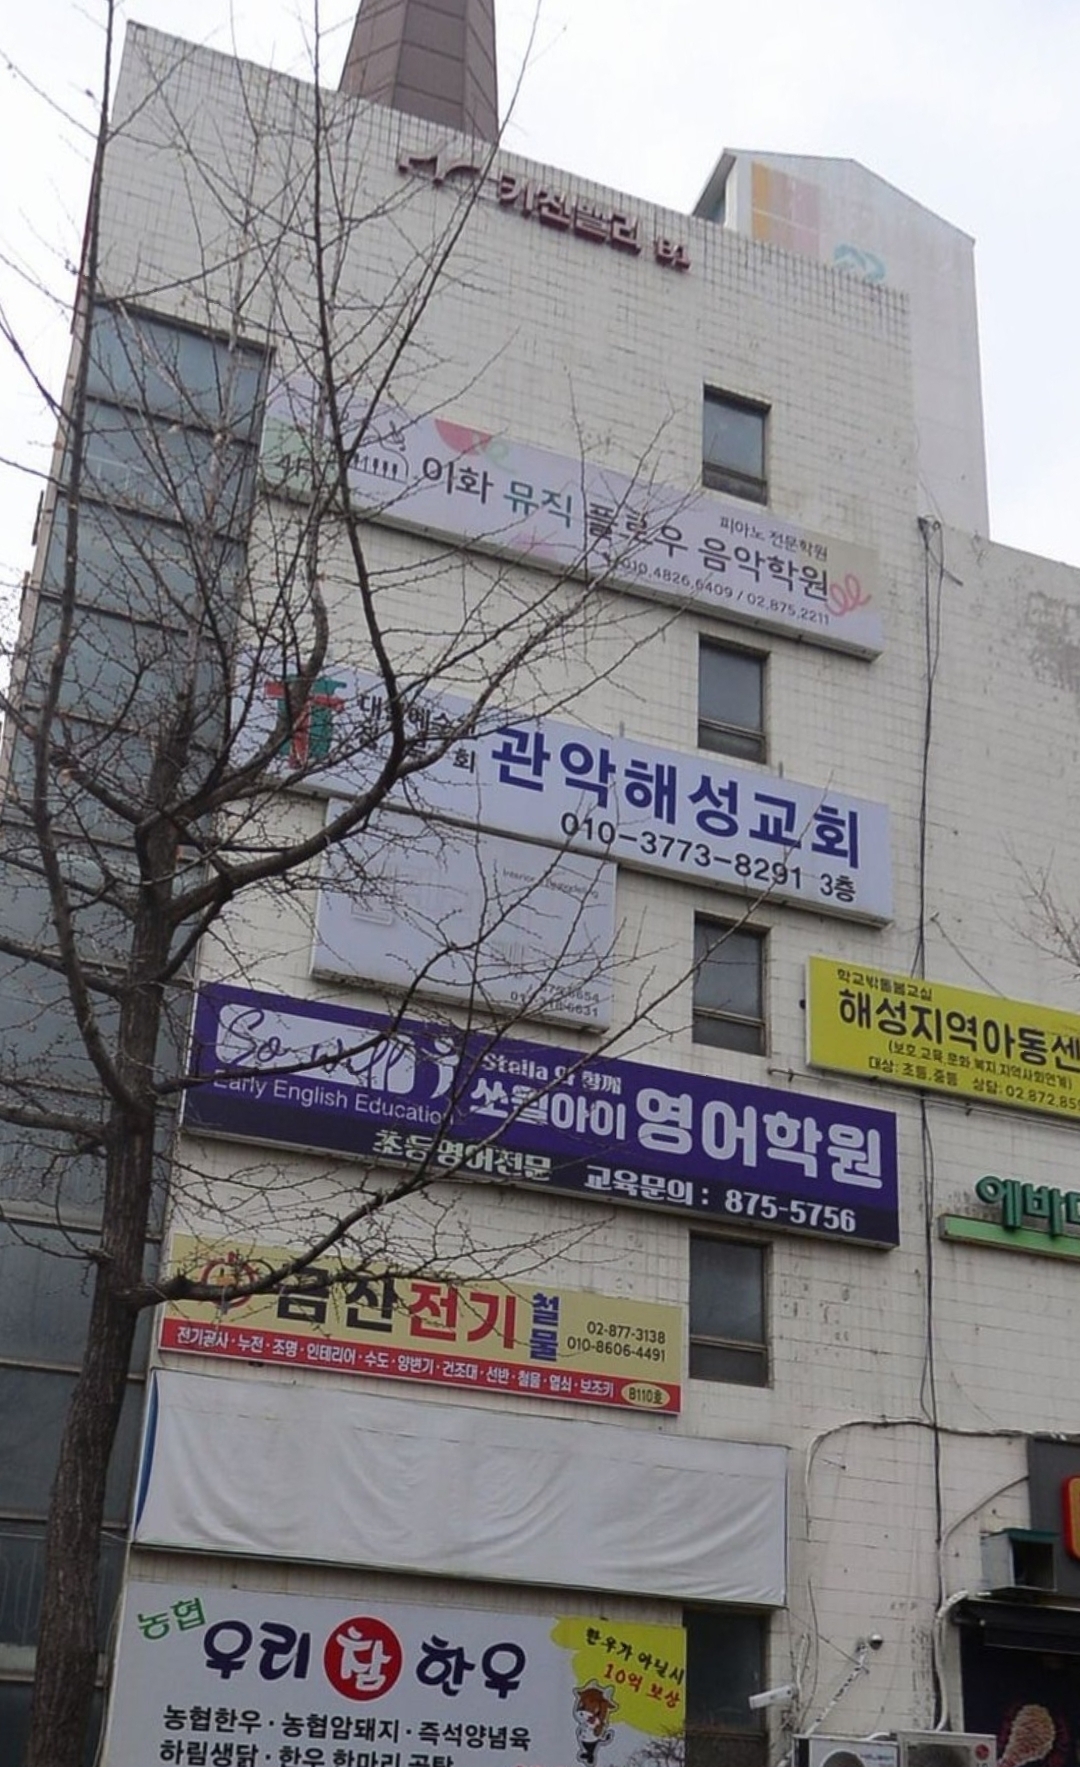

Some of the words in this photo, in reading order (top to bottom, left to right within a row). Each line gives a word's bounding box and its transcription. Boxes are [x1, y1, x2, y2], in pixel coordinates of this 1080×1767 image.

[423, 457, 493, 504] 이화
[503, 480, 572, 529] 뮤직
[698, 536, 828, 602] 음악학원
[720, 516, 765, 541] 피아노
[769, 530, 828, 562] 전문학원
[491, 728, 860, 869] 관악해성교회
[561, 812, 802, 890] 010-3773-8291
[819, 873, 857, 902] 3층
[838, 988, 1080, 1073] 해성지역아동센
[213, 1069, 267, 1098] Early
[274, 1080, 348, 1109] English
[482, 1052, 549, 1081] Stella
[581, 1071, 621, 1095] 함께
[637, 1088, 883, 1189] 영어학원
[372, 1129, 552, 1181] 초등영어전문
[724, 1189, 857, 1233] 875-5756
[530, 1292, 560, 1362] 철물
[567, 1336, 665, 1362] 010-8606-4491
[587, 1321, 665, 1345] 02-877-3138
[177, 1326, 229, 1349] 전기공사
[238, 1334, 264, 1353] 누전
[272, 1338, 299, 1357] 조명
[307, 1343, 356, 1365] 인테리어
[364, 1350, 389, 1368] 수도
[398, 1354, 434, 1375] 양변기
[442, 1360, 478, 1380] 건조대
[486, 1365, 510, 1384] 선반
[518, 1370, 541, 1389] 철물
[550, 1374, 572, 1392] 열쇠
[580, 1378, 614, 1398] 보조키
[629, 1387, 663, 1404] B110호
[137, 1597, 206, 1641] 농협
[203, 1620, 311, 1680] 우리
[416, 1634, 526, 1700] 한우
[586, 1627, 633, 1661] 한우가
[604, 1663, 643, 1692] 10억
[646, 1683, 681, 1709] 보상
[160, 1739, 259, 1767] 하림생닭
[279, 1745, 326, 1767] 한우
[332, 1748, 400, 1767] 한마리
[163, 1705, 262, 1734] 농협한우
[281, 1712, 399, 1743] 농협암돼지
[418, 1721, 532, 1751] 즉석양념육
